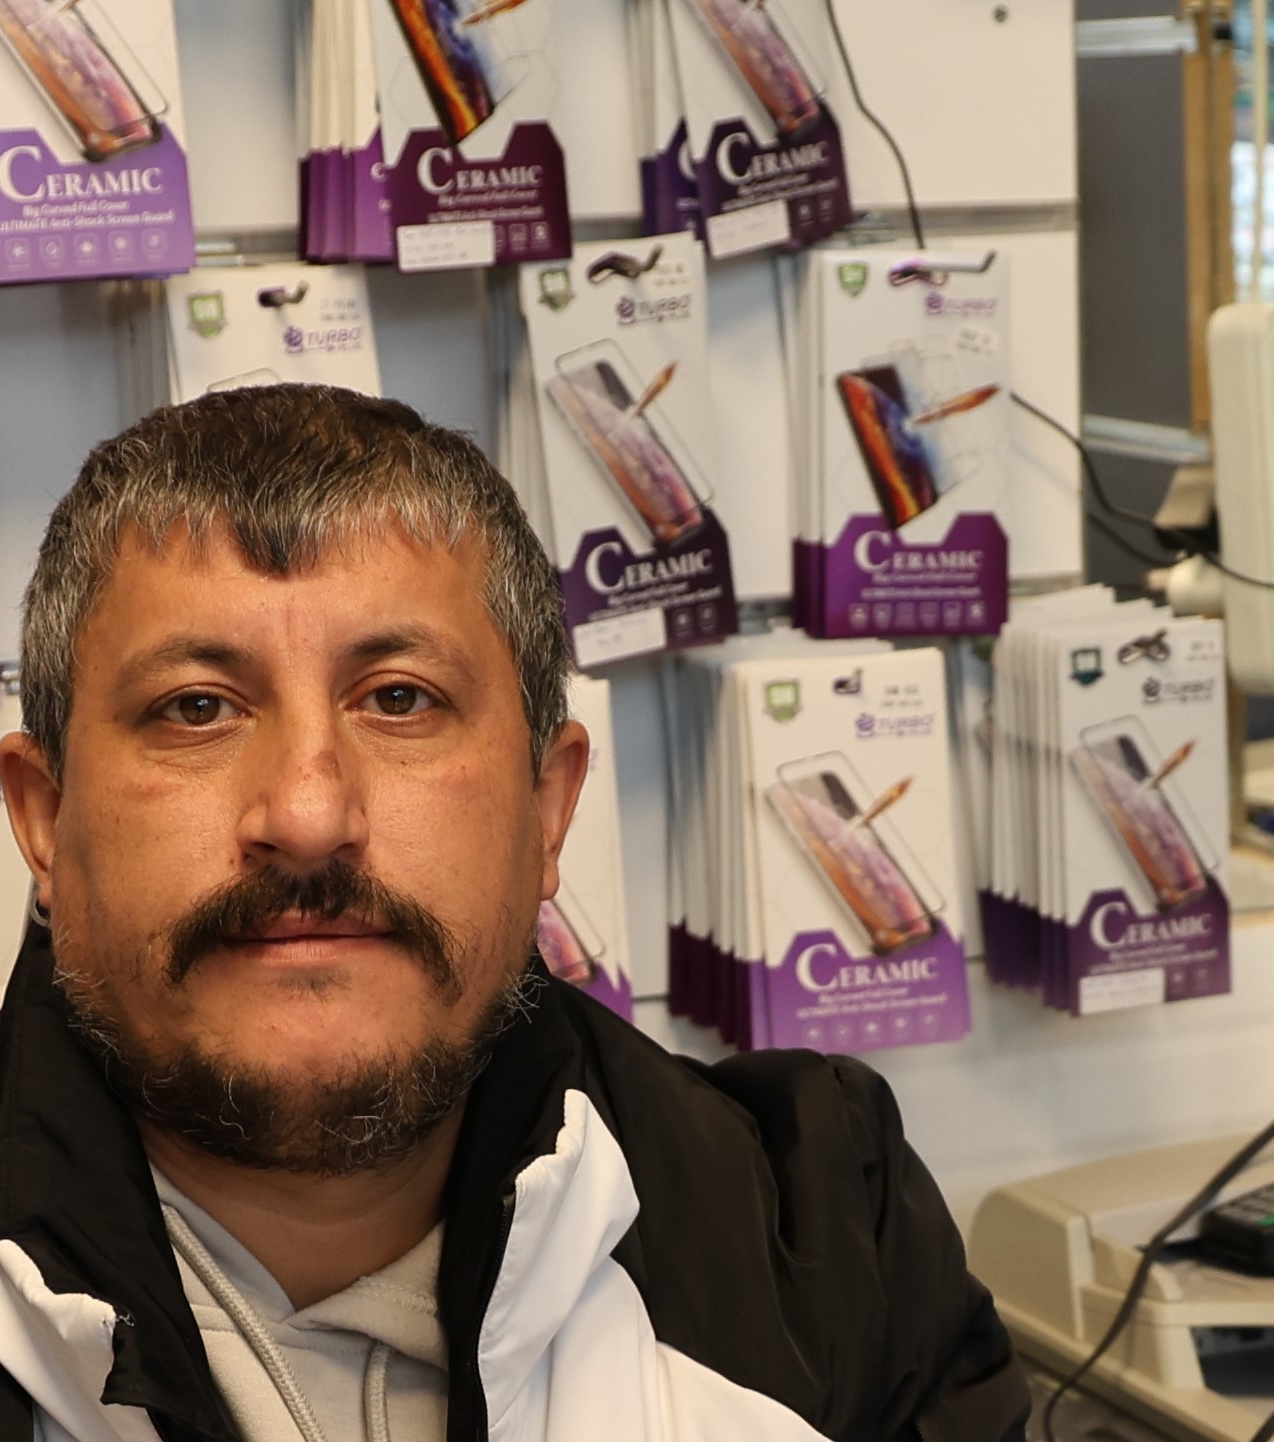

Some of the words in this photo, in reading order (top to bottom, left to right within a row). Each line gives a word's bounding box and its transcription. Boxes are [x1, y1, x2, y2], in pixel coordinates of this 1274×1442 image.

[417, 147, 543, 195] CERAMIC
[585, 541, 713, 594] CERAMIC
[853, 530, 983, 573] CERAMIC
[1089, 902, 1211, 949] CERAMIC
[795, 943, 938, 993] CERAMIC
